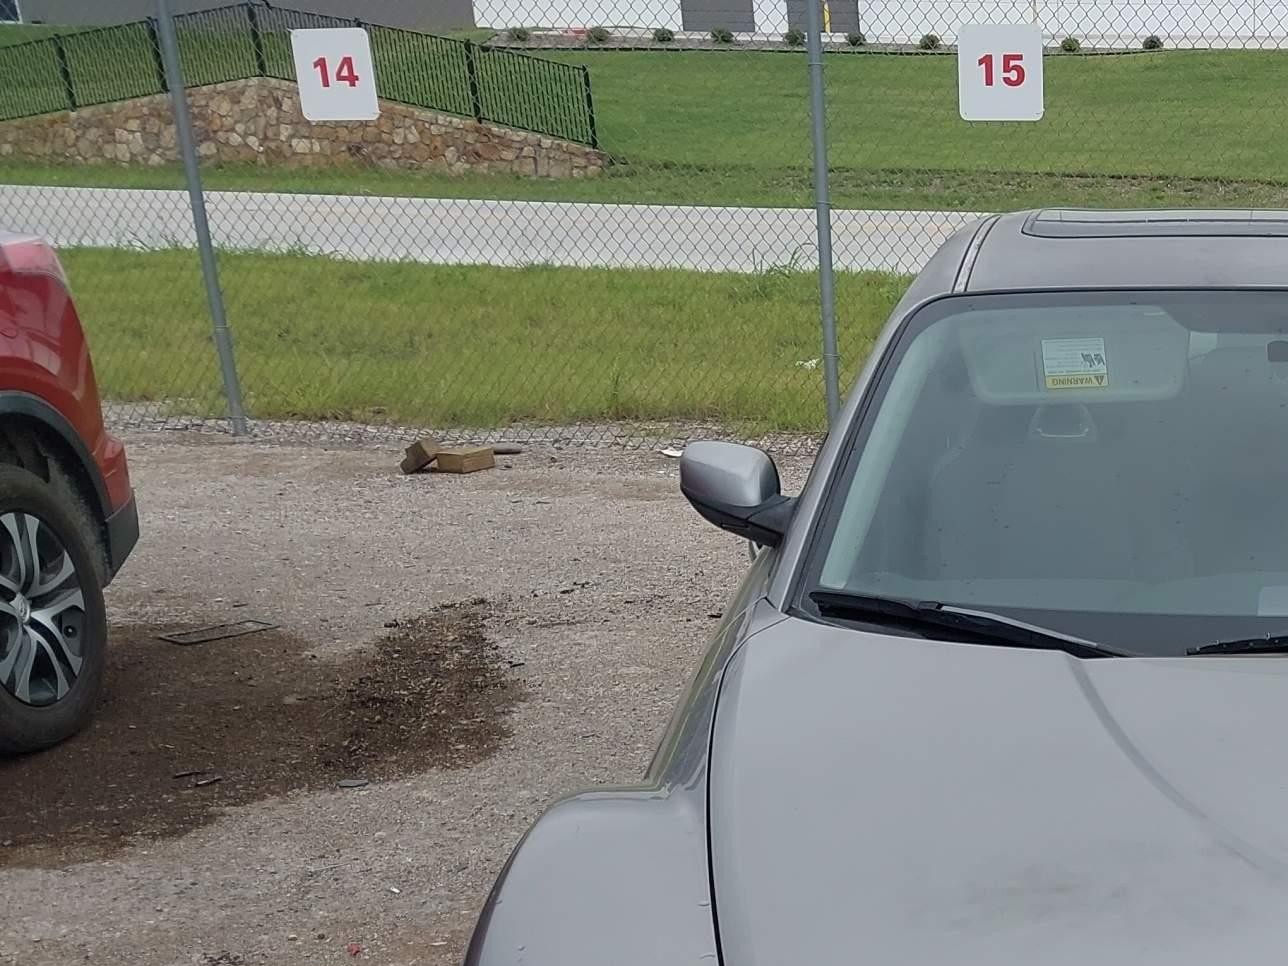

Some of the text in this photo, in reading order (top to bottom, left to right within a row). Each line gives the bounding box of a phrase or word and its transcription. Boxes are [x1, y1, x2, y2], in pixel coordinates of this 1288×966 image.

[313, 57, 359, 88] 14
[978, 54, 1025, 87] 15
[1052, 376, 1092, 386] WARNING
